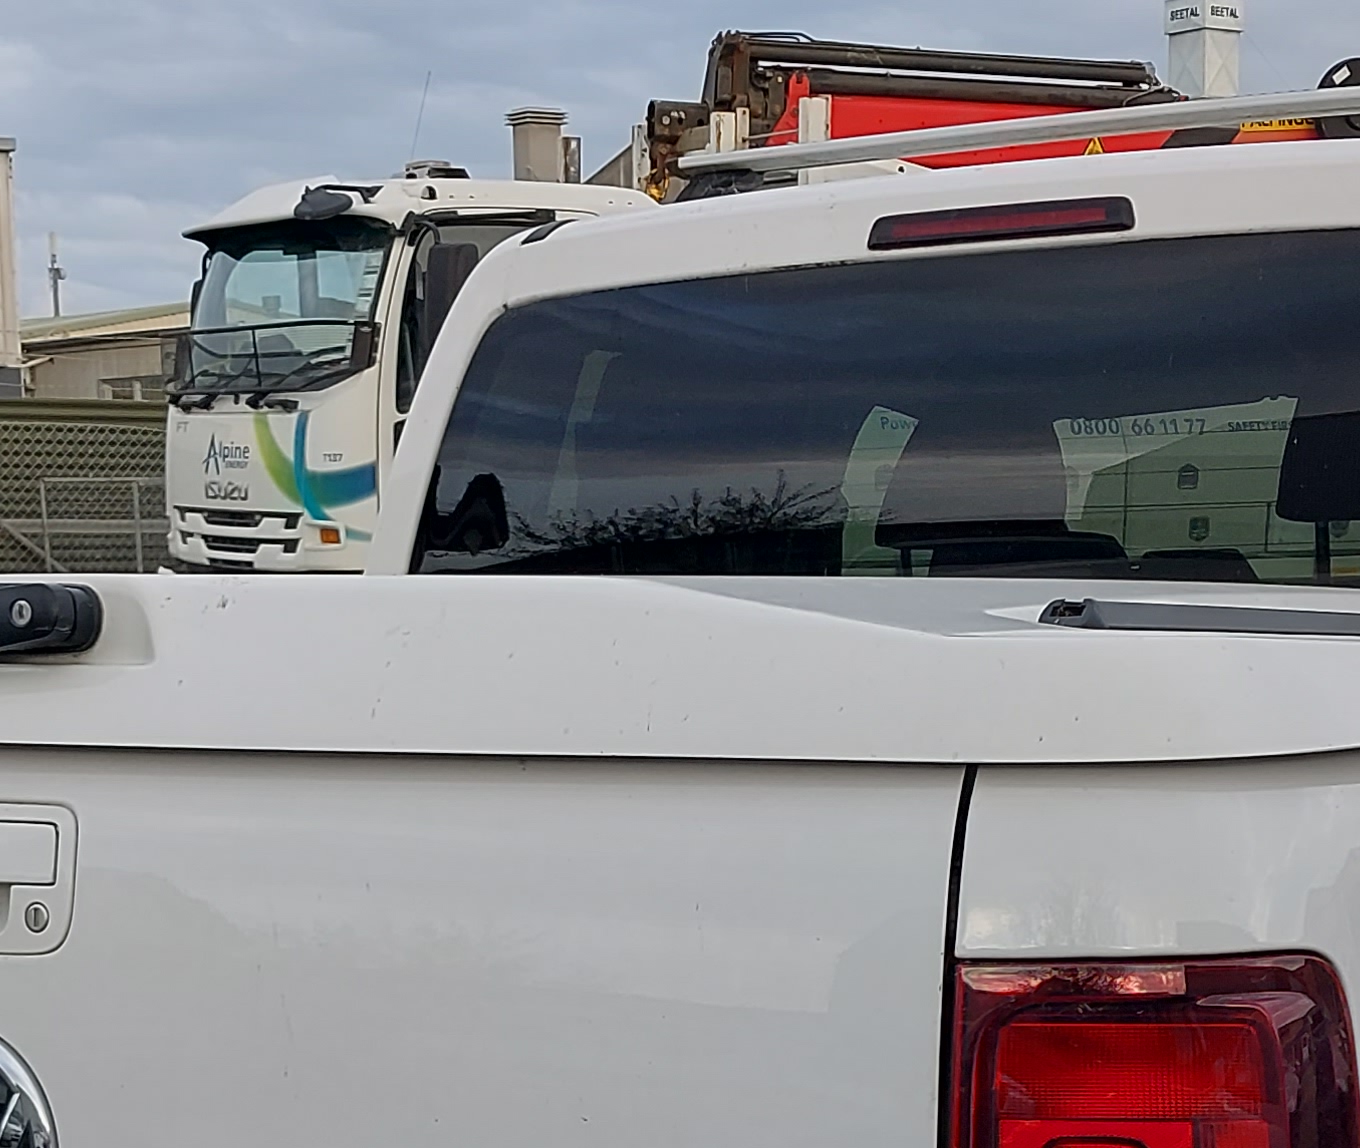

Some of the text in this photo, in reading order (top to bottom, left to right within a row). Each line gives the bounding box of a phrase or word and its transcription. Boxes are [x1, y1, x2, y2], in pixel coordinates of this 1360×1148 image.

[1069, 418, 1120, 436] 0800
[202, 432, 250, 475] Alpine
[205, 481, 249, 501] ISUZU
